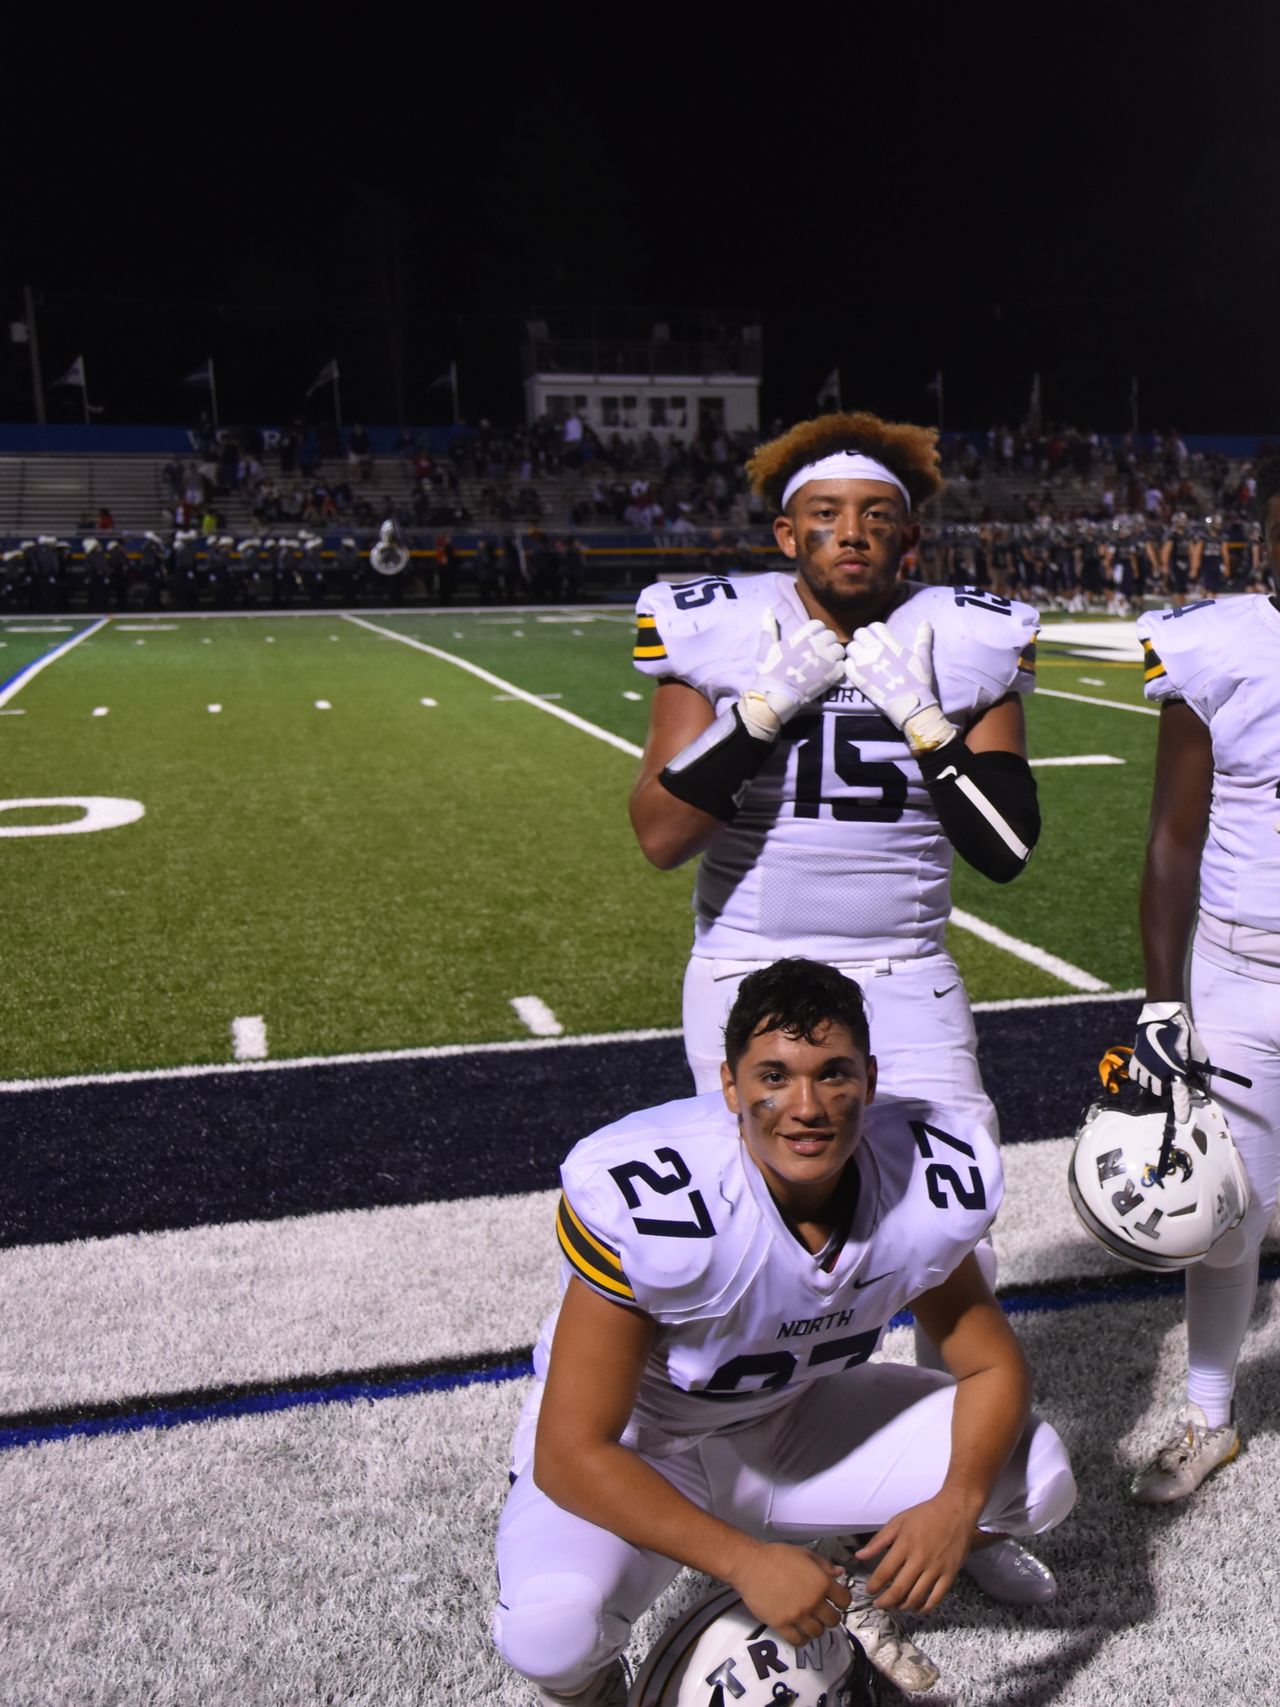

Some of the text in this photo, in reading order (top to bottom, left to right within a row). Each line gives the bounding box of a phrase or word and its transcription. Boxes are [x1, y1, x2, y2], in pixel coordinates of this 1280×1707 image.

[782, 715, 909, 822] 15
[608, 1147, 717, 1239] 27
[908, 1120, 987, 1210] 27
[776, 1309, 854, 1339] NORTH
